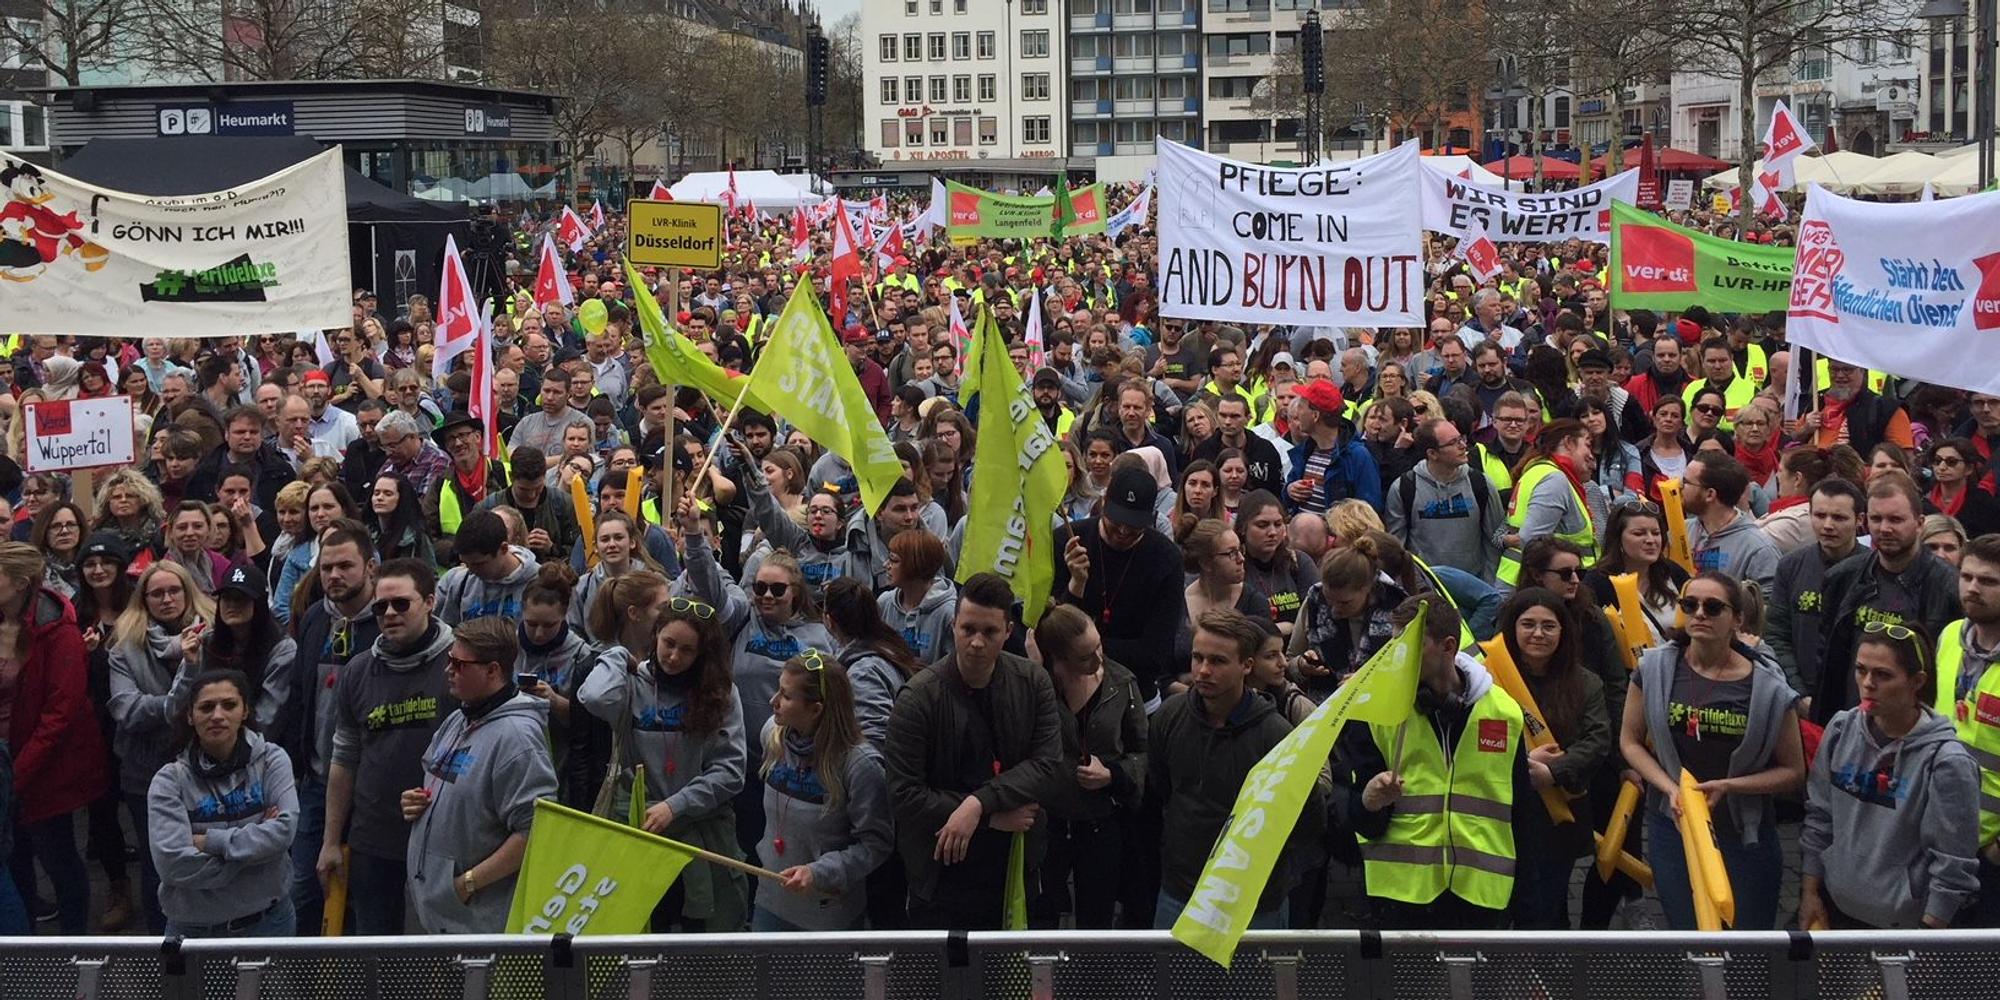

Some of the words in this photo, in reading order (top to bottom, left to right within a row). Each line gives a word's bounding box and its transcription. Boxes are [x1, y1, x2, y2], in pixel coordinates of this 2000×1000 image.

[220, 113, 287, 126] Heumarkt
[897, 108, 917, 117] GAG
[928, 150, 970, 160] APOSTEL
[1446, 178, 1507, 208] WIR
[1517, 189, 1602, 213] SIND
[652, 217, 697, 228] LVR-Klinik
[995, 218, 1042, 229] Langenfeld
[1232, 211, 1303, 241] COME
[1317, 214, 1348, 243] IN
[1450, 203, 1491, 231] ES
[1501, 211, 1591, 236] WERT.
[113, 221, 182, 242] GÖNN
[192, 226, 235, 241] ICH
[245, 218, 305, 240] MIR!!!
[635, 234, 714, 251] Düsseldorf
[1162, 247, 1233, 306] AND
[1242, 253, 1325, 311] BURN
[1343, 255, 1417, 313] OUT
[1627, 264, 1688, 282] ver.di
[1880, 258, 1929, 290] Stärkt
[1932, 258, 1965, 291] den
[1713, 275, 1792, 292] LVR-HP
[1976, 299, 2000, 313] ver
[1480, 738, 1506, 749] ver.di
